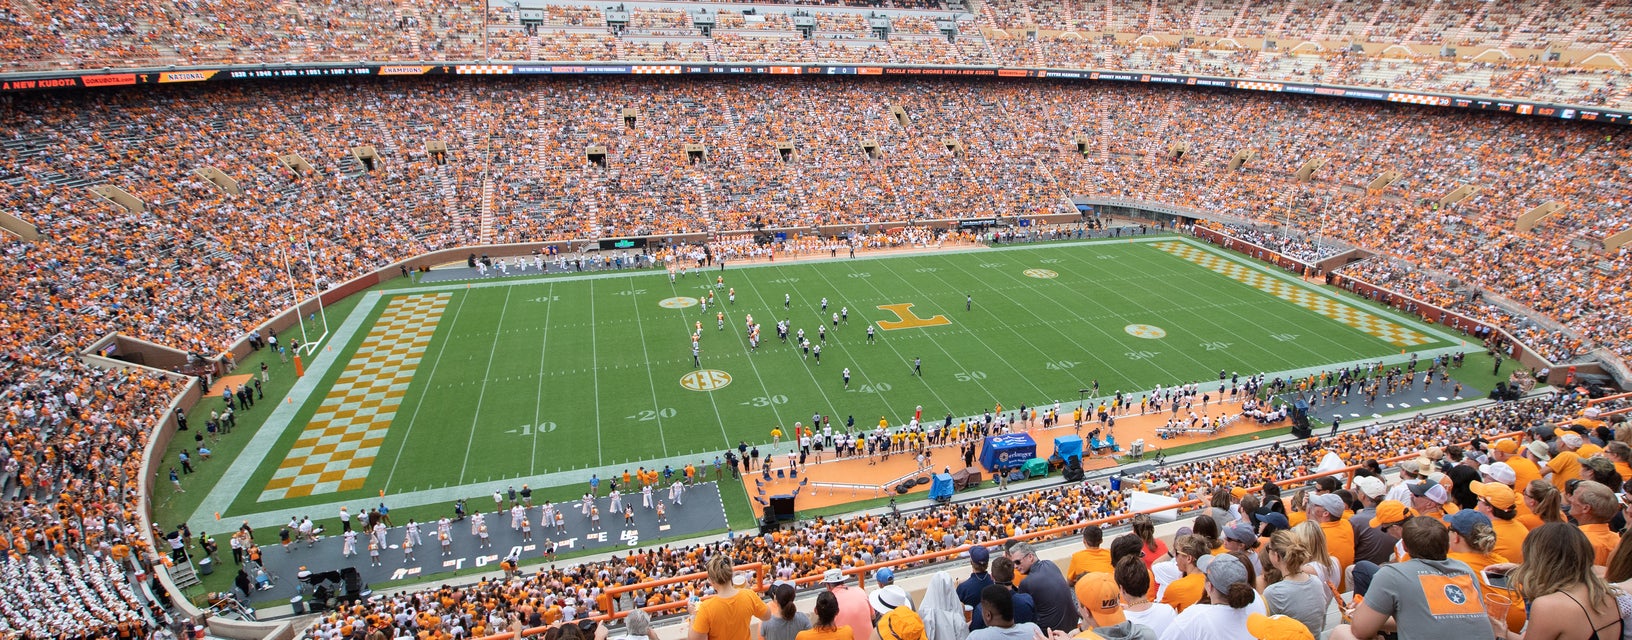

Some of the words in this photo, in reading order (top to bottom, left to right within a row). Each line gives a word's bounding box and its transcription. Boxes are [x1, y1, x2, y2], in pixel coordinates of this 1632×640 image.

[3, 82, 10, 90] A
[13, 81, 35, 89] NEW
[39, 78, 76, 88] KUBOTA
[1046, 359, 1076, 370] 40
[954, 370, 987, 382] 50
[857, 382, 892, 394] 40
[752, 394, 789, 407] 30
[638, 407, 677, 421] 20
[519, 421, 557, 436] 10
